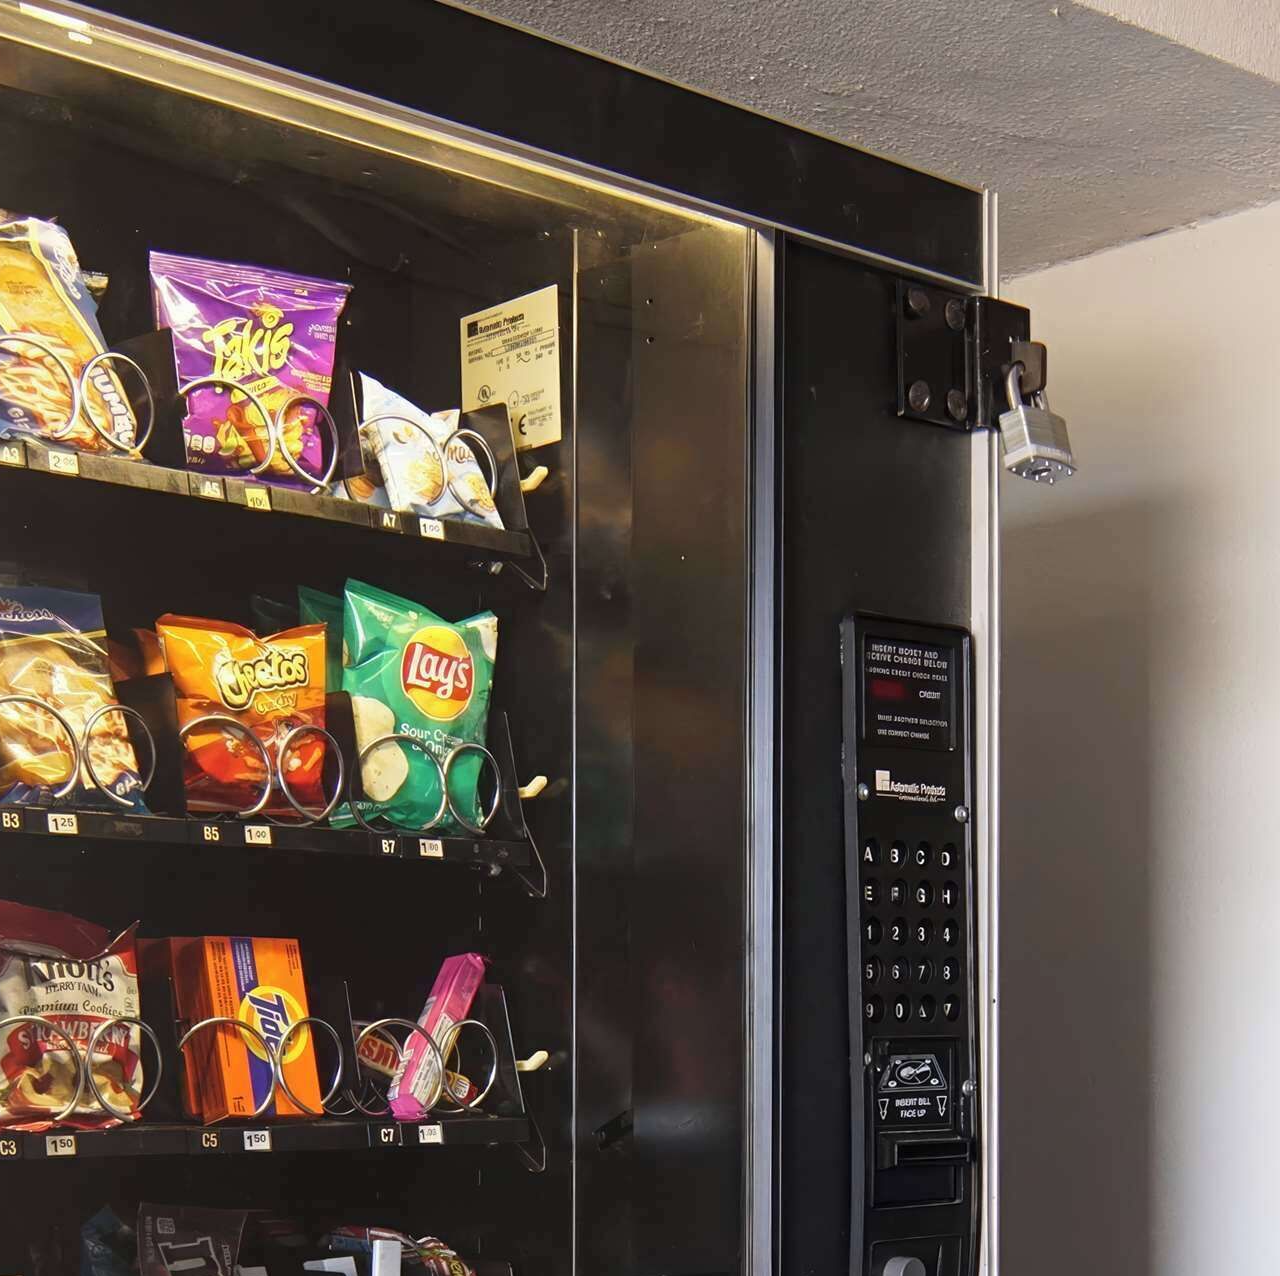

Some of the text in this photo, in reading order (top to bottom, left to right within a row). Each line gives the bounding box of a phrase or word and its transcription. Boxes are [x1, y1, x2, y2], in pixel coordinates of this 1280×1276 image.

[202, 306, 293, 380] Takis
[382, 513, 396, 528] A7
[406, 642, 470, 699] Lay's
[216, 651, 309, 709] Cheetos
[400, 723, 431, 739] Sour
[2, 812, 20, 829] B3
[204, 826, 220, 841] B5
[381, 839, 395, 853] B7
[863, 847, 950, 866] A B C D
[864, 885, 950, 904] E F G H
[866, 925, 950, 942] 1 2 3 4
[866, 964, 950, 980] 5 6 7 8
[82, 999, 123, 1017] Cookies
[866, 1003, 903, 1018] 9 0
[202, 1133, 218, 1148] C5
[380, 1128, 395, 1142] C7
[0, 1140, 17, 1156] C3
